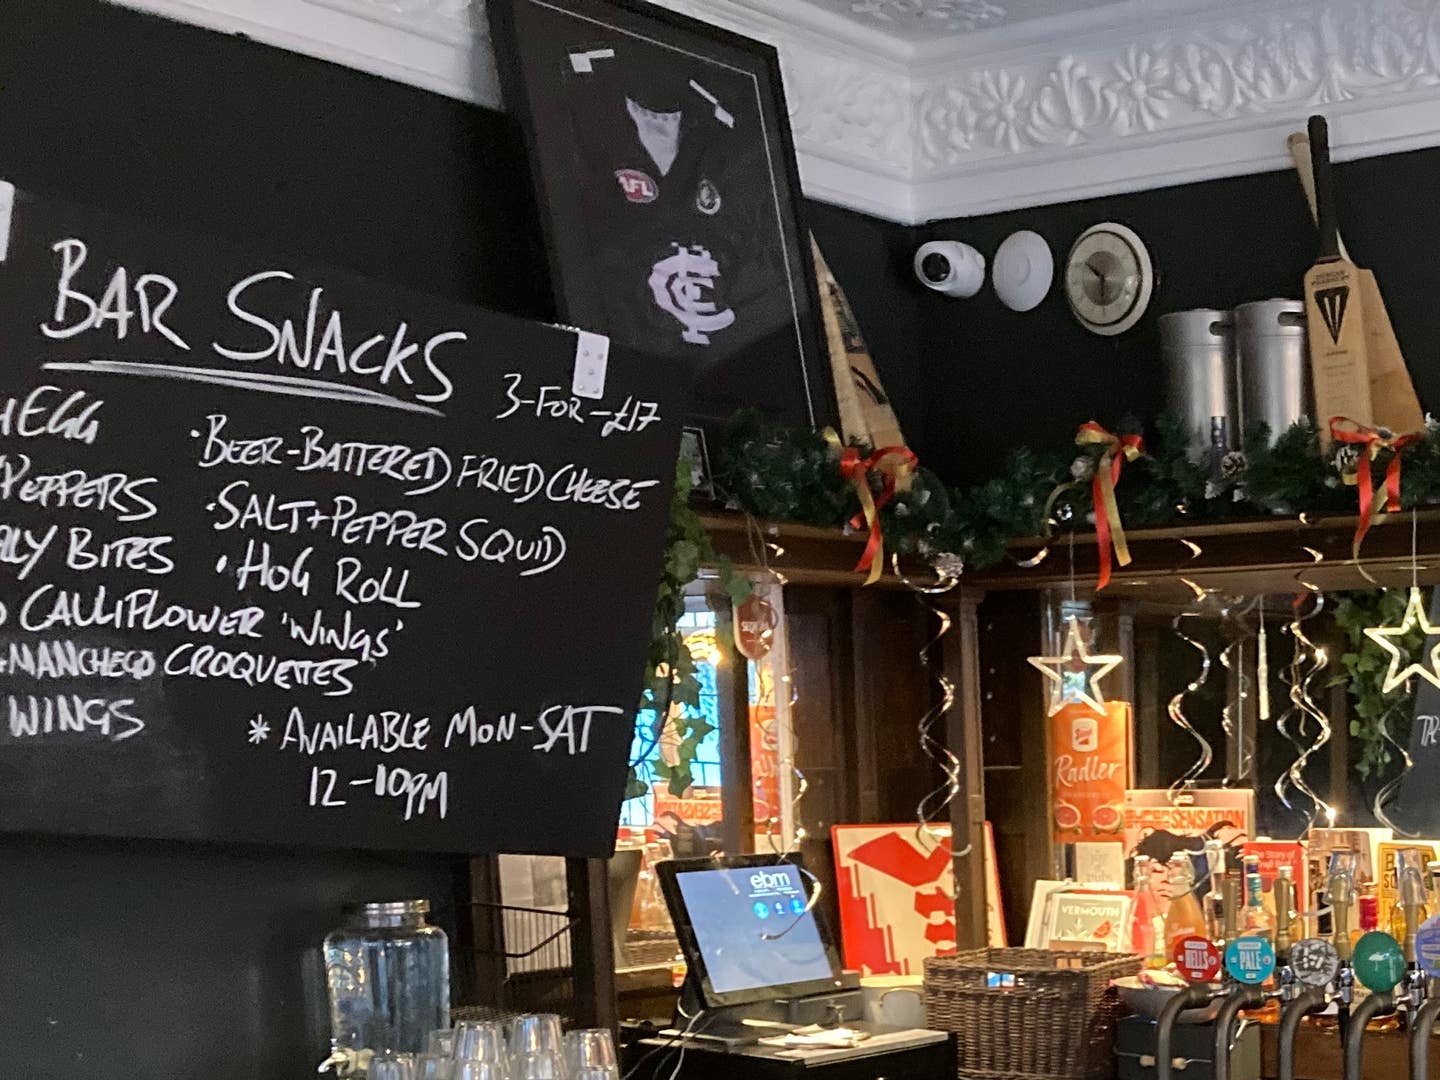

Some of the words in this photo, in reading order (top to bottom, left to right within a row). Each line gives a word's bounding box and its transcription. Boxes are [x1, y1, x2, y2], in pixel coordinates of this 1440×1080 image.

[42, 238, 191, 351] BAR
[212, 270, 468, 403] SNACKS
[456, 454, 545, 503] FRIED
[546, 463, 661, 510] CHEESE
[67, 527, 174, 575] BITES
[456, 518, 567, 576] SQUID
[237, 542, 311, 597] HOG
[336, 557, 422, 608] ROLL
[20, 583, 264, 639] CAULIFLOWER
[163, 643, 361, 696] CROQUETTES
[9, 694, 146, 742] WINGS
[280, 710, 431, 754] AVAILABLE
[1054, 754, 1121, 787] Radler
[1171, 807, 1246, 830] SENSATION
[750, 870, 791, 889] ebm
[1061, 905, 1120, 917] VERMOUTH
[1184, 950, 1208, 970] HELLS
[1239, 950, 1262, 970] PALE
